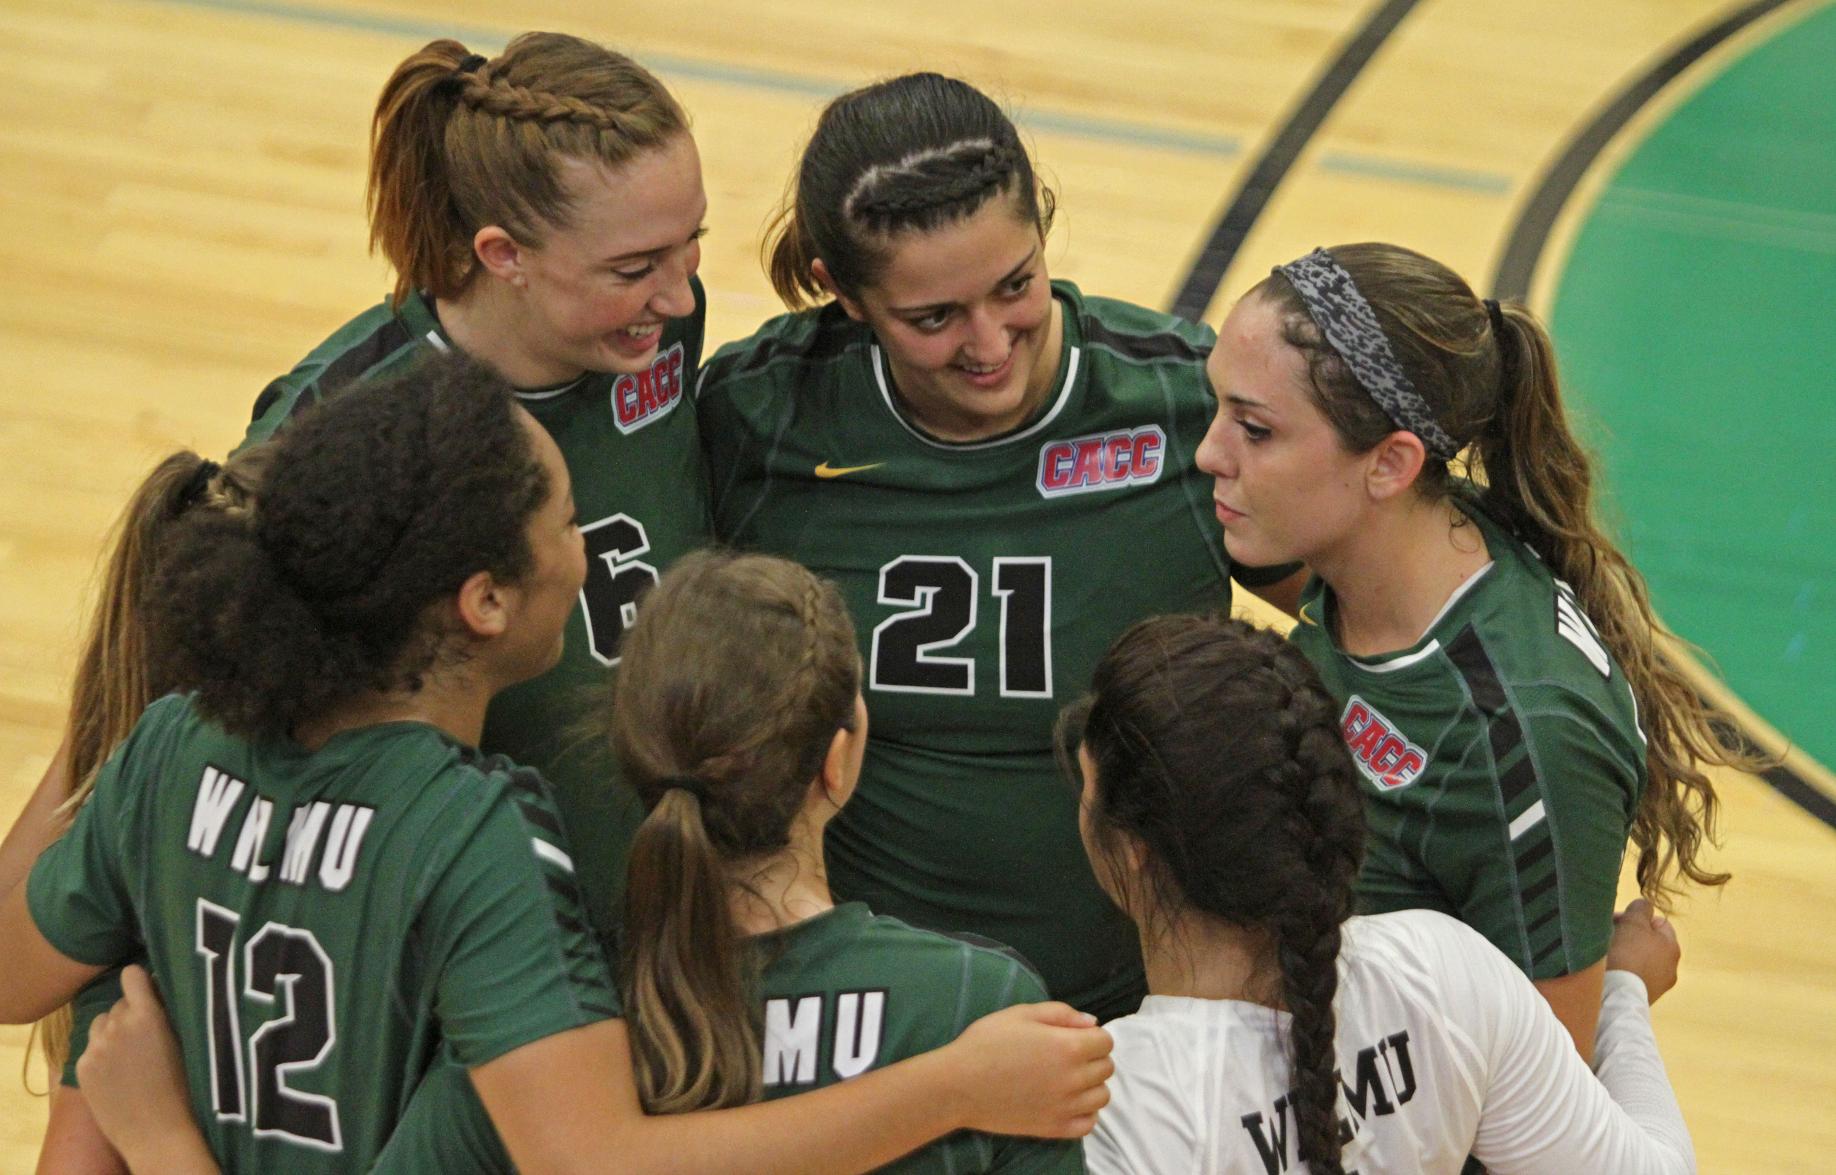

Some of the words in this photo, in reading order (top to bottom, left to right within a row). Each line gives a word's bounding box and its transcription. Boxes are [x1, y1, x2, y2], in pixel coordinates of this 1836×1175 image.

[613, 346, 683, 429] CACC
[1039, 430, 1163, 493] CACC
[869, 554, 1053, 699] 21
[1343, 700, 1425, 788] CACC
[195, 897, 344, 1152] 12
[1240, 1029, 1417, 1174] WMU
